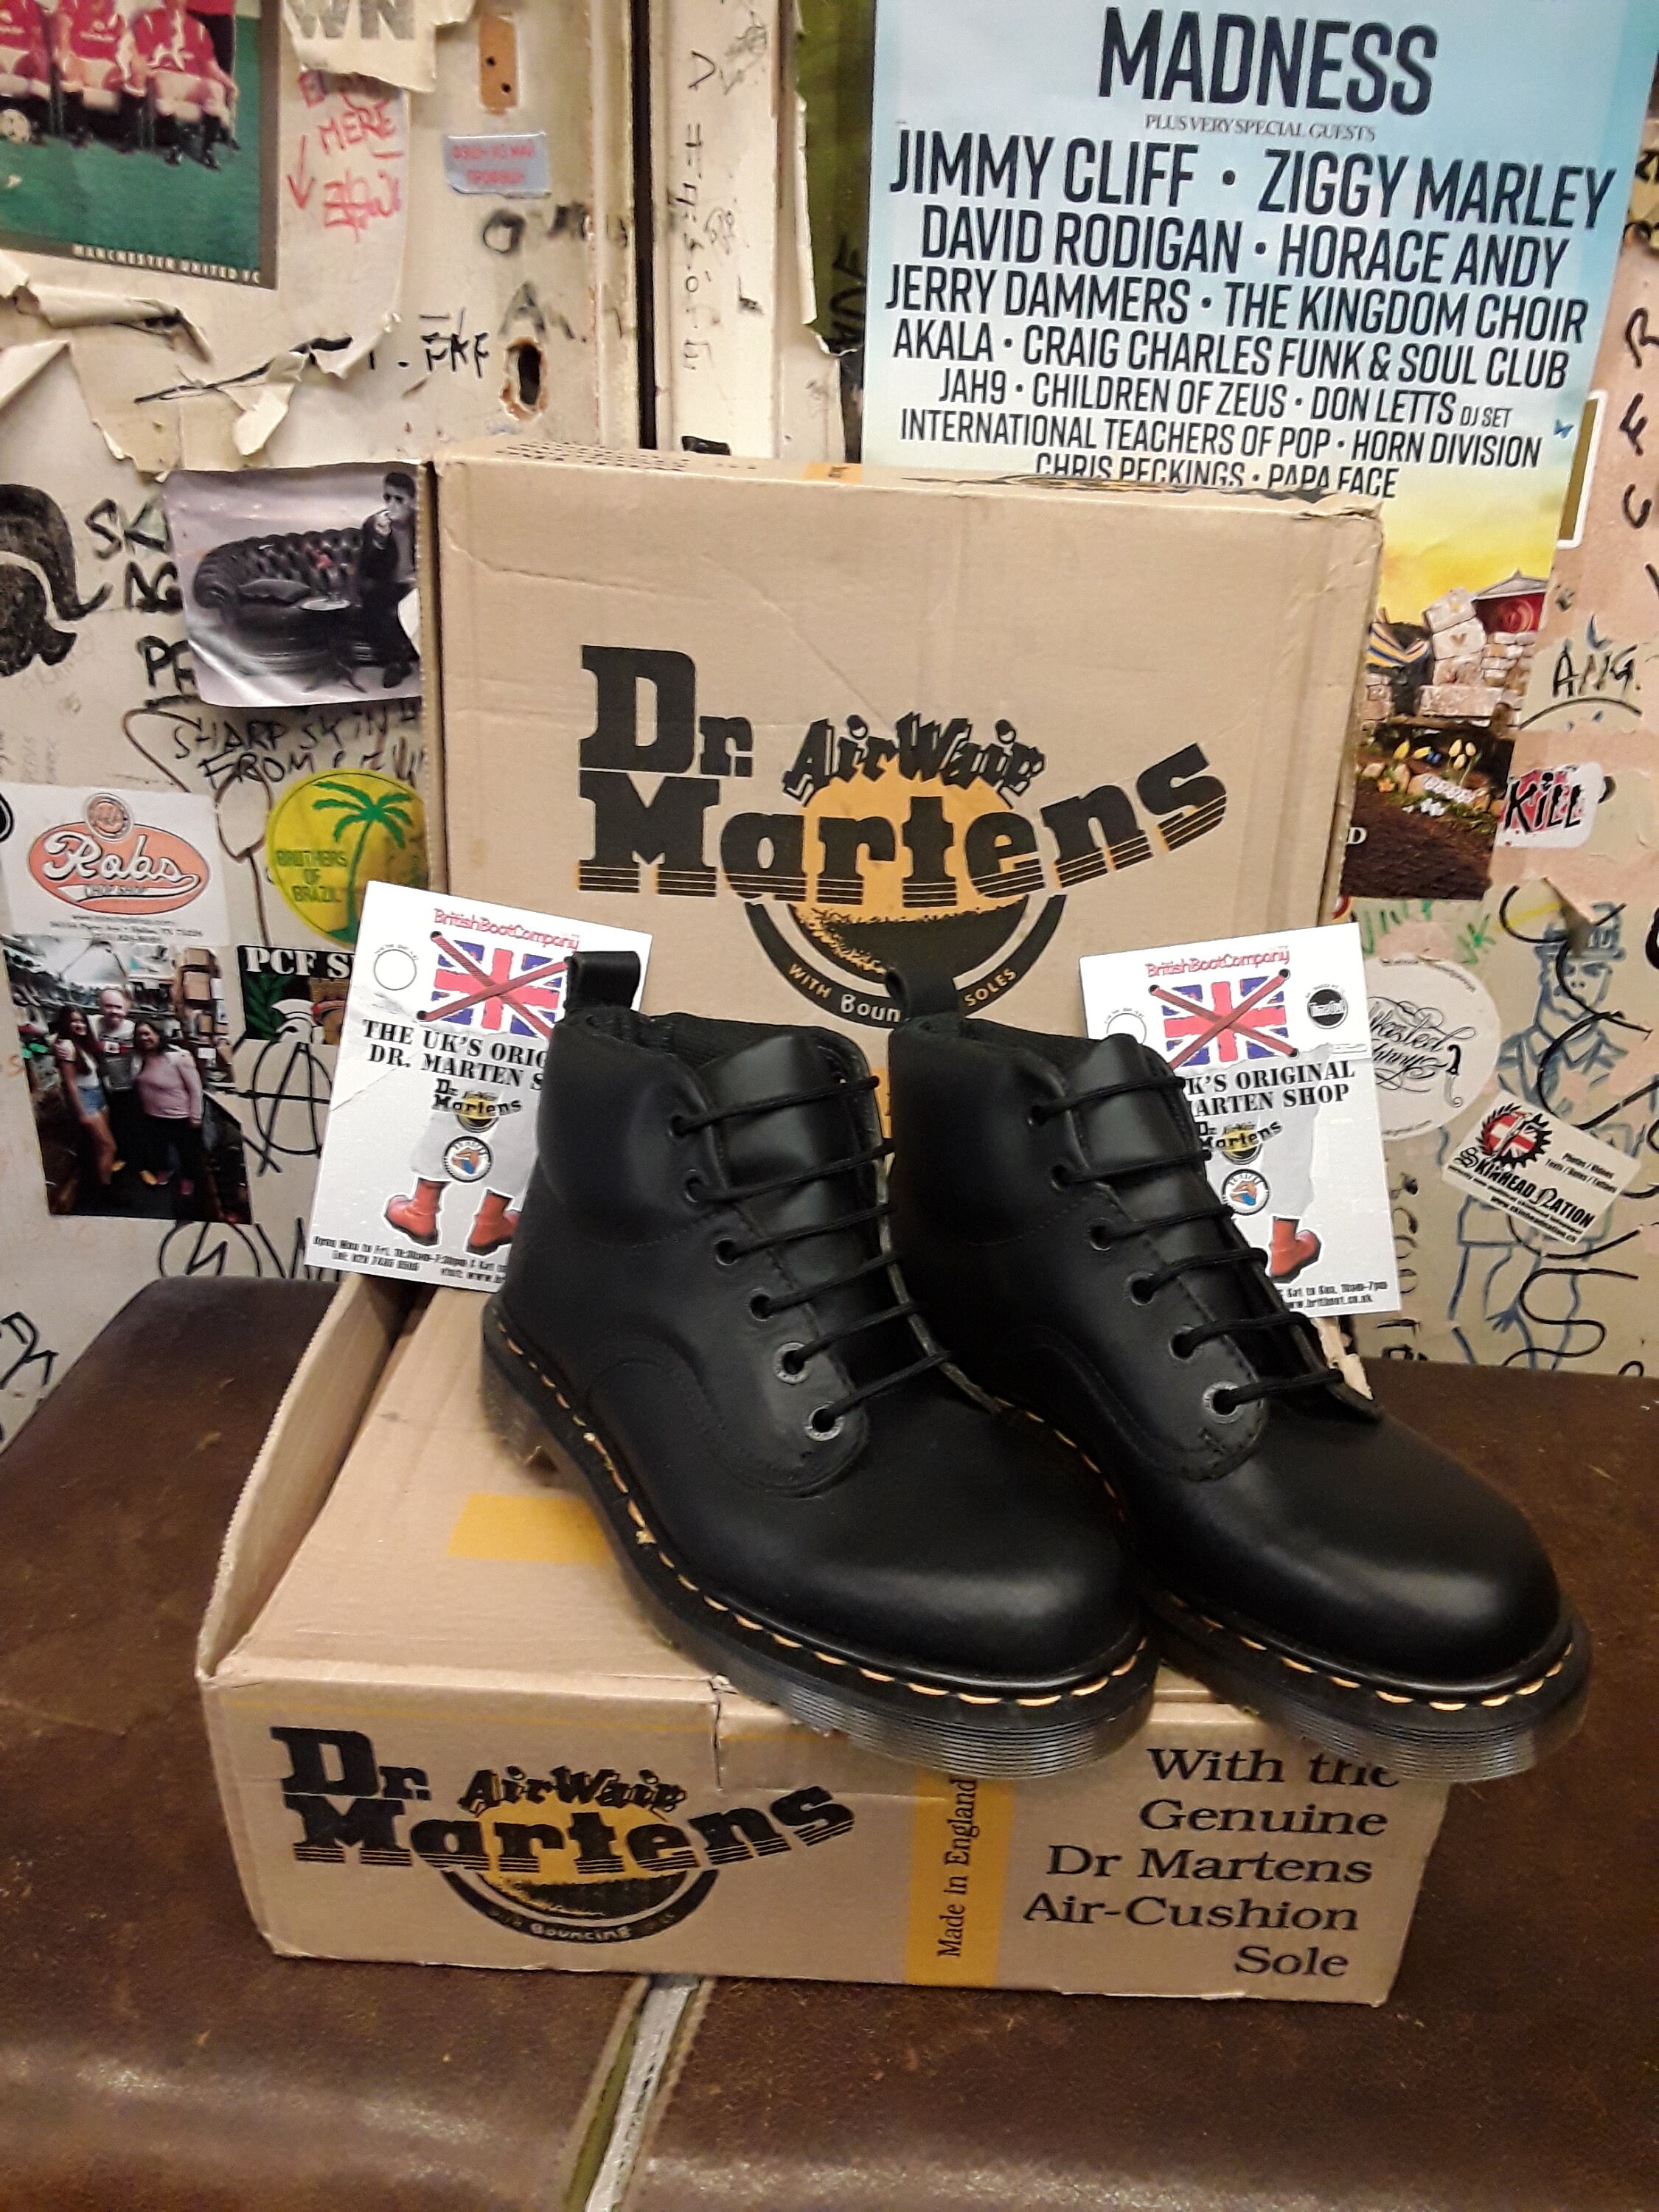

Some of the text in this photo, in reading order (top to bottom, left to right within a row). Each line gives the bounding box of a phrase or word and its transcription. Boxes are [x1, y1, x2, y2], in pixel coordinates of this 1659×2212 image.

[1098, 7, 1438, 115] MADNESS
[1144, 114, 1376, 142] PLUS VERY SPECIAL GUESTS
[890, 130, 1055, 201] JIMMY
[1064, 138, 1200, 207] CLIFF
[1258, 149, 1409, 218] ZIGGY
[1413, 158, 1618, 229] MARLEY
[922, 204, 1571, 288] DAVID RODIGAN HORACE ANDY
[885, 264, 998, 314] JERRY
[1004, 270, 1192, 324] DAMMERS
[1224, 282, 1293, 330] THE
[1298, 284, 1469, 338] KINGDOM
[1475, 294, 1589, 344] CHOIR
[893, 318, 1571, 389] AKALA CRAIG CHARLES FUNK & SOUL CLUB
[939, 368, 1514, 428] JAH9 CHILDREN OF ZEUS DON LETTS DJ SET
[900, 408, 1544, 468] INTERNATIONAL TEACHERS OF POP HORN DIVISION
[1036, 453, 1113, 479] CHRIS
[1267, 464, 1329, 492] PAPA
[1337, 465, 1401, 499] FACE
[782, 712, 1048, 808] AirWair
[577, 742, 1227, 908] Martens
[41, 830, 201, 884] Robs
[244, 947, 318, 976] PCF
[789, 963, 833, 998] WITH
[841, 993, 902, 1023] Boun
[963, 967, 1017, 1007] SOLES
[362, 1019, 414, 1044] THE
[422, 1029, 484, 1057] UK'S
[367, 1043, 412, 1068] DR.
[420, 1053, 524, 1088] MARTEN
[1186, 1060, 1355, 1096] K'S ORIGINAL
[1194, 1083, 1349, 1117] ARTEN SHOP
[1147, 1747, 1285, 1783] With
[284, 1784, 856, 1874] Martens
[945, 1779, 980, 1865] England
[1138, 1798, 1389, 1837] Genuine
[1047, 1844, 1373, 1884] Dr Martens
[936, 1904, 965, 1957] Made
[1023, 1891, 1360, 1932] Air-Cushion
[1234, 1945, 1349, 1977] Sole
